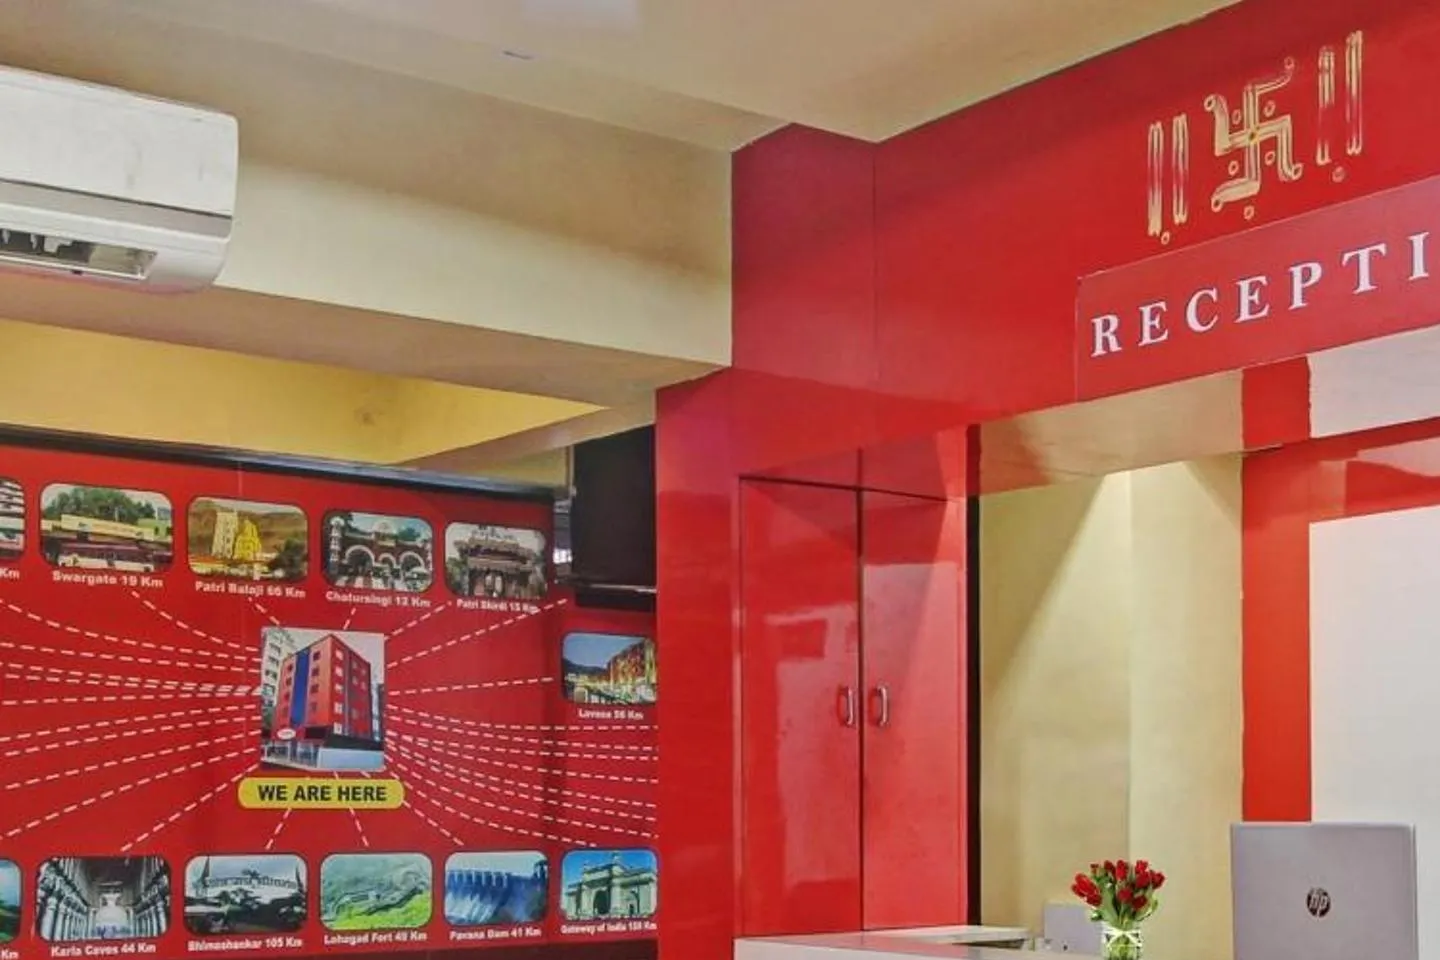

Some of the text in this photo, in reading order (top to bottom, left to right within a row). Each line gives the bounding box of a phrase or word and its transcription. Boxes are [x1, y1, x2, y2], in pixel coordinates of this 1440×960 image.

[52, 570, 163, 587] Swargate 19 Km
[285, 587, 306, 598] Km
[411, 597, 431, 608] Km
[627, 709, 644, 720] Km
[258, 785, 387, 802] WE ARE HERE
[1307, 887, 1330, 917] hp
[410, 929, 427, 941] Km
[525, 926, 542, 937] Km
[286, 936, 303, 948] Km
[1, 949, 19, 960] Km
[51, 942, 156, 958] Karla Caves 44 Km
